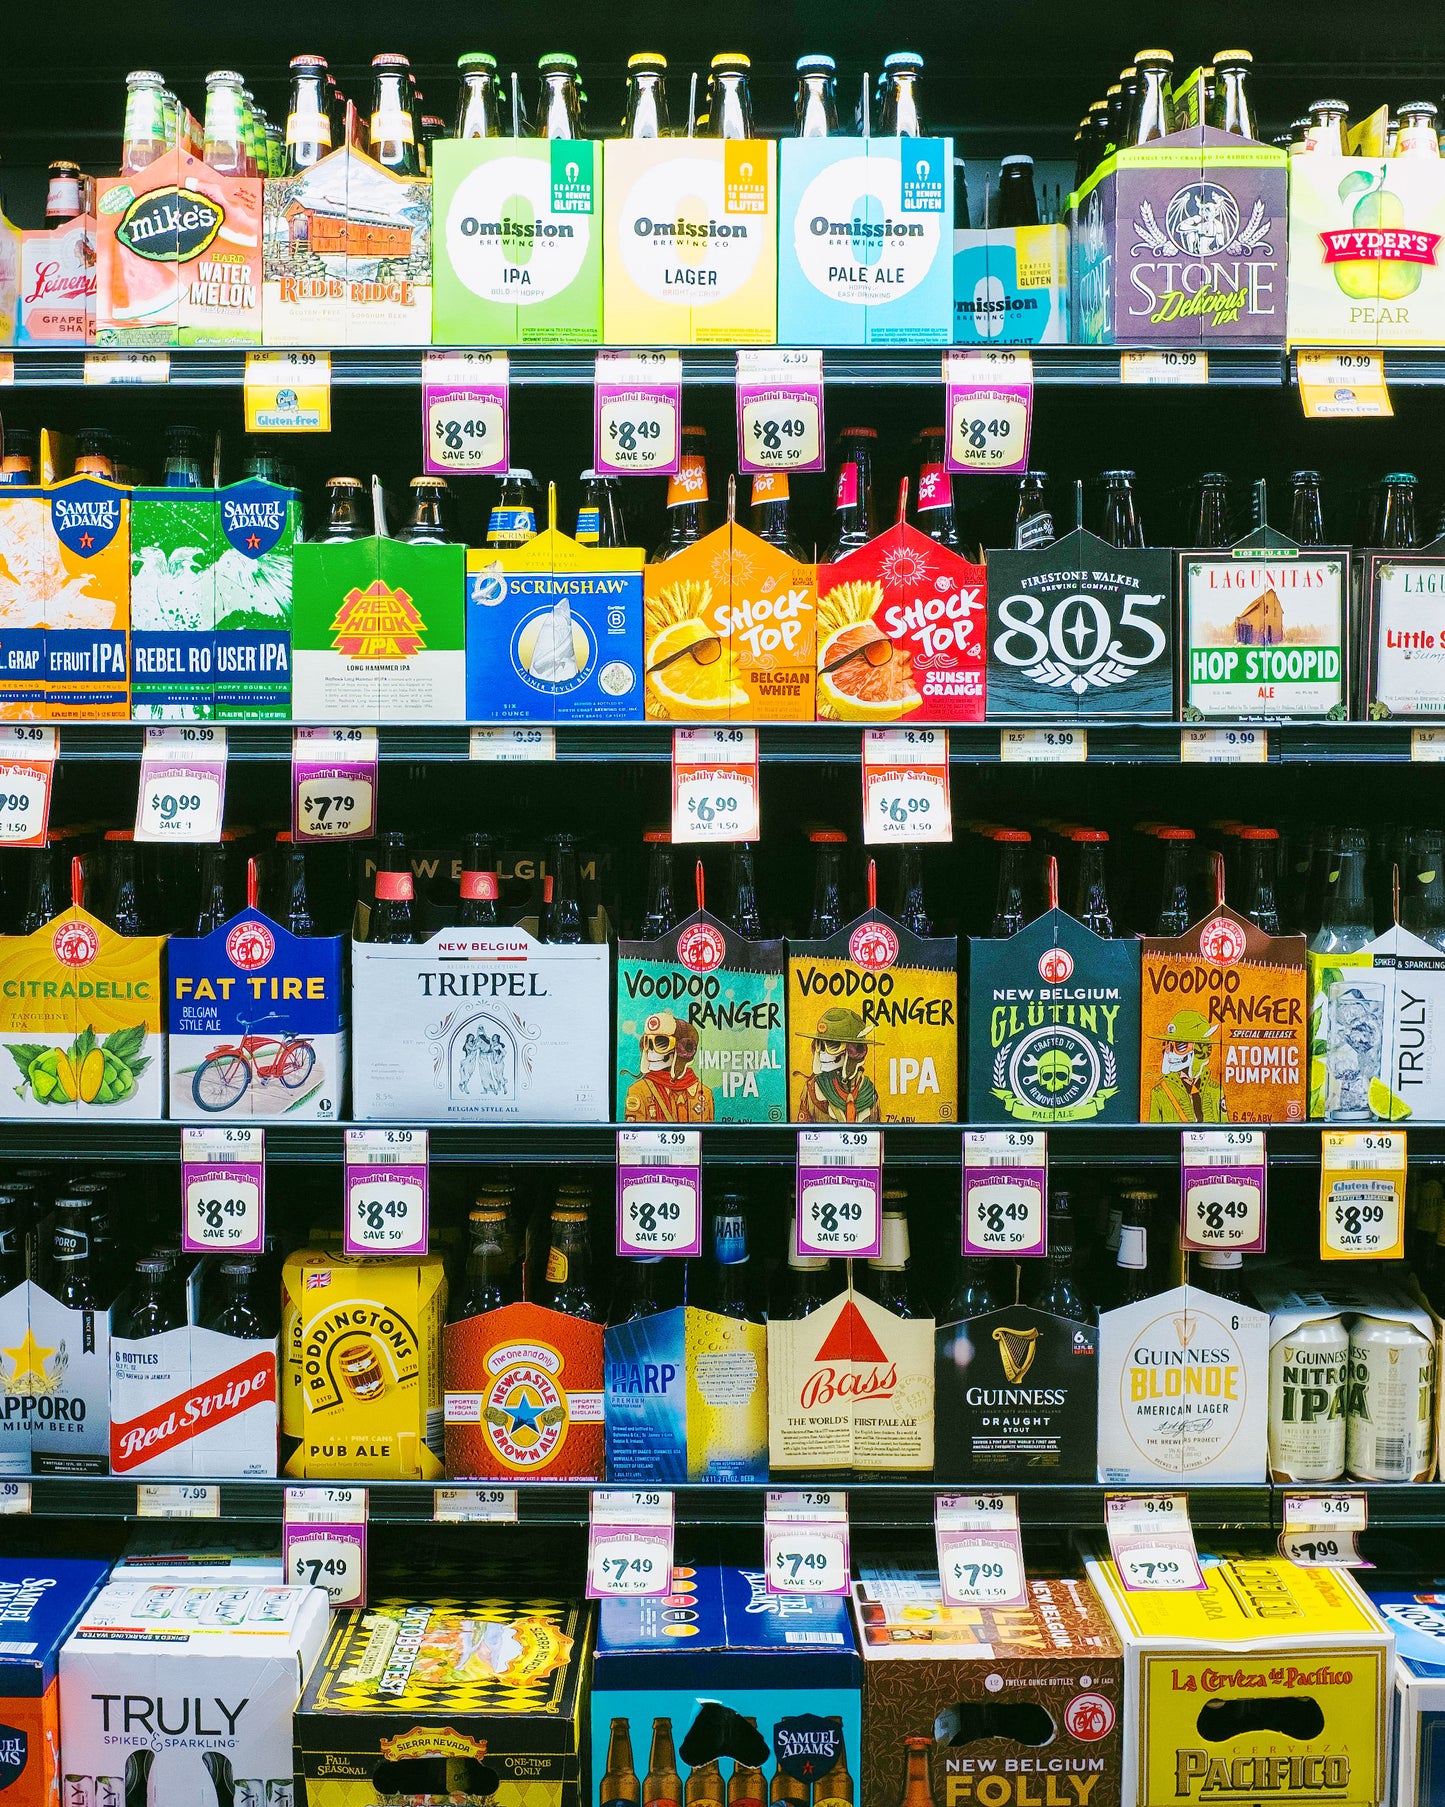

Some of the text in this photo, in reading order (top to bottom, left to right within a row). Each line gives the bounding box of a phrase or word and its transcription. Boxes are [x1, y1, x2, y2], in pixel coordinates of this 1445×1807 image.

[554, 199, 591, 211] GLUTEN
[904, 198, 941, 210] GLUTEN
[131, 206, 217, 243] mike's
[460, 217, 574, 238] Omission
[634, 217, 747, 238] Omission
[810, 216, 924, 237] Omission
[1330, 233, 1429, 251] WYDER'S
[212, 253, 245, 264] HARD
[1359, 249, 1401, 257] CIDER
[198, 262, 252, 284] WATER
[504, 268, 531, 285] IPA
[665, 269, 717, 286] LAGER
[828, 267, 905, 283] PALE ALE
[190, 283, 256, 309] MELON
[1129, 262, 1277, 316] STONE
[1151, 284, 1248, 324] Delicious
[1211, 310, 1239, 327] IPA
[1350, 307, 1410, 324] PEAR
[56, 500, 118, 516] SAMUEL
[224, 501, 284, 516] SAMUEL
[60, 514, 113, 531] ADAMS
[228, 515, 279, 531] ADAMS
[510, 580, 624, 595] SCRIMSHAW
[1021, 571, 1140, 589] FIRESTONE WALKER
[1041, 583, 1119, 593] BREWING COMPANY
[1209, 569, 1324, 590] LAGUNITAS
[355, 602, 402, 614] RED
[714, 589, 813, 635] SHOCK
[885, 589, 984, 637] SHOCK
[344, 616, 406, 632] HOOK
[993, 594, 1167, 667] 805
[359, 638, 396, 655] IPA
[738, 620, 802, 658] TOP
[911, 620, 969, 658] TOP
[136, 648, 184, 672] REBEL
[259, 644, 287, 671] IPA
[1193, 651, 1339, 680] HOP STOOPID
[750, 671, 810, 685] BELGIAN
[925, 672, 980, 683] SUNSET
[758, 684, 801, 696] WHITE
[921, 683, 982, 696] ORANGE
[1257, 687, 1275, 699] ALE
[689, 821, 713, 831] SAVE
[438, 943, 528, 951] NEW BELGIUM
[418, 972, 547, 997] TRIPPEL
[624, 971, 720, 999] VOODOO
[797, 967, 894, 998] VOODOO
[1148, 965, 1241, 994] VOODOO
[3, 980, 150, 1000] CITRADELIC
[175, 977, 325, 1000] FAT TIRE
[993, 988, 1119, 1000] NEW BELGIUM
[11, 1013, 69, 1021] TANGERINE
[182, 1006, 218, 1019] BELGIAN
[688, 1000, 782, 1030] RANGER
[861, 997, 955, 1027] RANGER
[1208, 995, 1303, 1025] RANGER
[179, 1018, 221, 1031] STYLE ALE
[1232, 1030, 1293, 1038] SPECIAL RELEASE
[1398, 990, 1426, 1091] TRULY
[1034, 1038, 1074, 1052] CRAFTED TO
[699, 1049, 781, 1071] IMPERIAL
[1226, 1045, 1299, 1066] ATOMIC
[889, 1058, 940, 1095] IPA
[1225, 1066, 1299, 1084] PUMPKIN
[722, 1071, 759, 1098] IPA
[1029, 1086, 1080, 1106] REMOVE GLUTEN
[1032, 1110, 1074, 1118] PALE ALE
[635, 1232, 658, 1242] SAVE
[310, 1308, 412, 1391] BODDINGTONS
[1134, 1348, 1230, 1365] GUINNESS
[115, 1352, 158, 1365] 6 BOTTLES
[611, 1364, 676, 1393] HARP
[801, 1362, 897, 1409] Bass
[1130, 1366, 1239, 1402] BLONDE
[495, 1370, 557, 1405] NEWCASTLE
[966, 1388, 1063, 1406] GUINNESS
[119, 1369, 266, 1459] Red Stripe
[1137, 1403, 1229, 1416] AMERICAN LAGER
[50, 1422, 84, 1432] BEER
[788, 1416, 917, 1427] THE WORLD'S FIRST PALE ALE
[982, 1417, 1051, 1426] DRAUGHT
[310, 1446, 390, 1457] PUB ALE
[493, 1428, 558, 1461] BROWN ALE
[1005, 1678, 1073, 1686] TWELVE OUNCE BOTTLES
[1172, 1670, 1197, 1692] La
[1269, 1668, 1284, 1682] del
[91, 1695, 249, 1736] TRULY
[104, 1735, 147, 1746] SPIKED
[165, 1737, 235, 1748] SPARKLING
[397, 1738, 470, 1752] SIERRA NEVADA
[778, 1730, 839, 1745] SAMUEL
[782, 1743, 835, 1758] ADAMS
[1233, 1744, 1349, 1754] CERVEZA
[325, 1755, 350, 1764] FALL
[505, 1757, 551, 1768] ONE-TIME
[946, 1759, 1104, 1771] NEW BELGIUM
[317, 1764, 367, 1775] SEASONAL
[514, 1766, 542, 1776] ONLY
[1175, 1749, 1350, 1796] PACIFICO
[947, 1775, 1100, 1807] FOLLY
